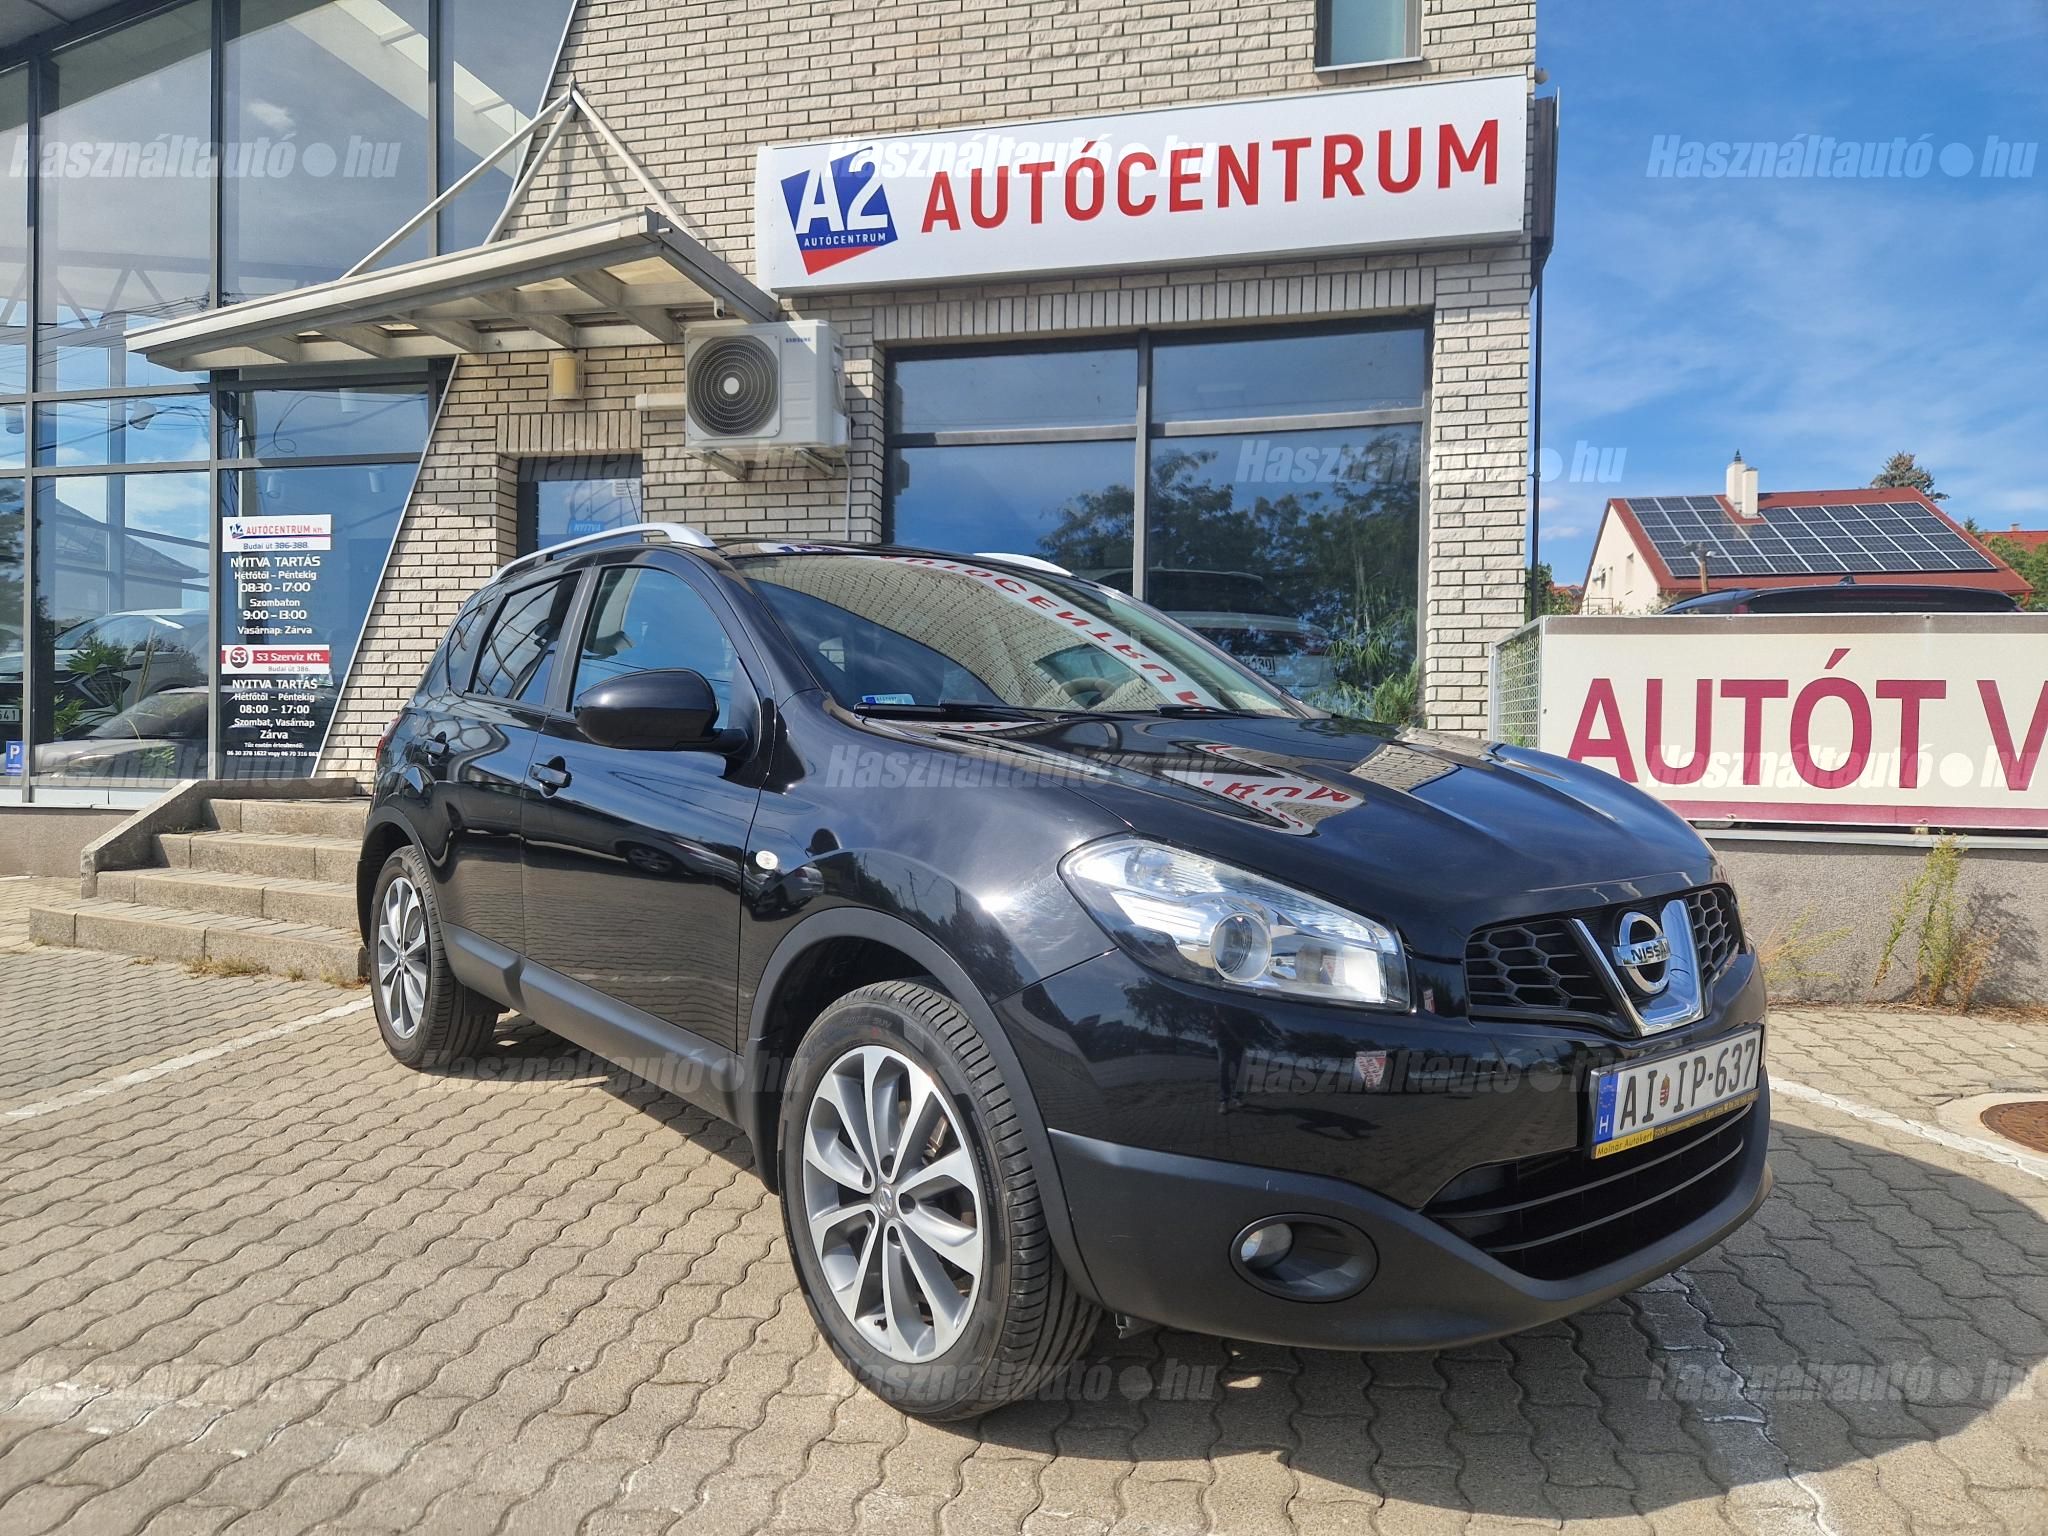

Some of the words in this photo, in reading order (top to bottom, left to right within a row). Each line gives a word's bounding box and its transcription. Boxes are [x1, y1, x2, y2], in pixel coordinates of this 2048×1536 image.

[921, 118, 1499, 233] AUTÓCENTRUM
[796, 146, 888, 234] A2
[804, 232, 886, 247] AUTÓCENTRUM
[230, 556, 271, 568] NYITVA
[274, 554, 321, 567] TARTÁS
[282, 582, 311, 592] 17:00
[249, 598, 301, 607] Szombaton
[243, 609, 269, 620] 9:00
[279, 609, 307, 620] 13:00
[284, 625, 313, 635] Zárva
[231, 650, 247, 663] S3
[256, 653, 269, 661] S3
[270, 652, 305, 661] Szerviz
[232, 679, 272, 689] NYITVA
[276, 677, 318, 689] TARTÁS
[278, 692, 315, 702] Péntekig
[239, 704, 269, 714] 08:00
[281, 704, 310, 714] 17:00
[275, 718, 315, 728] Vasárnap
[1567, 648, 1947, 791] AUTÓT
[260, 729, 289, 739] Zárva
[10, 745, 20, 759] P
[1598, 1115, 1609, 1135] H
